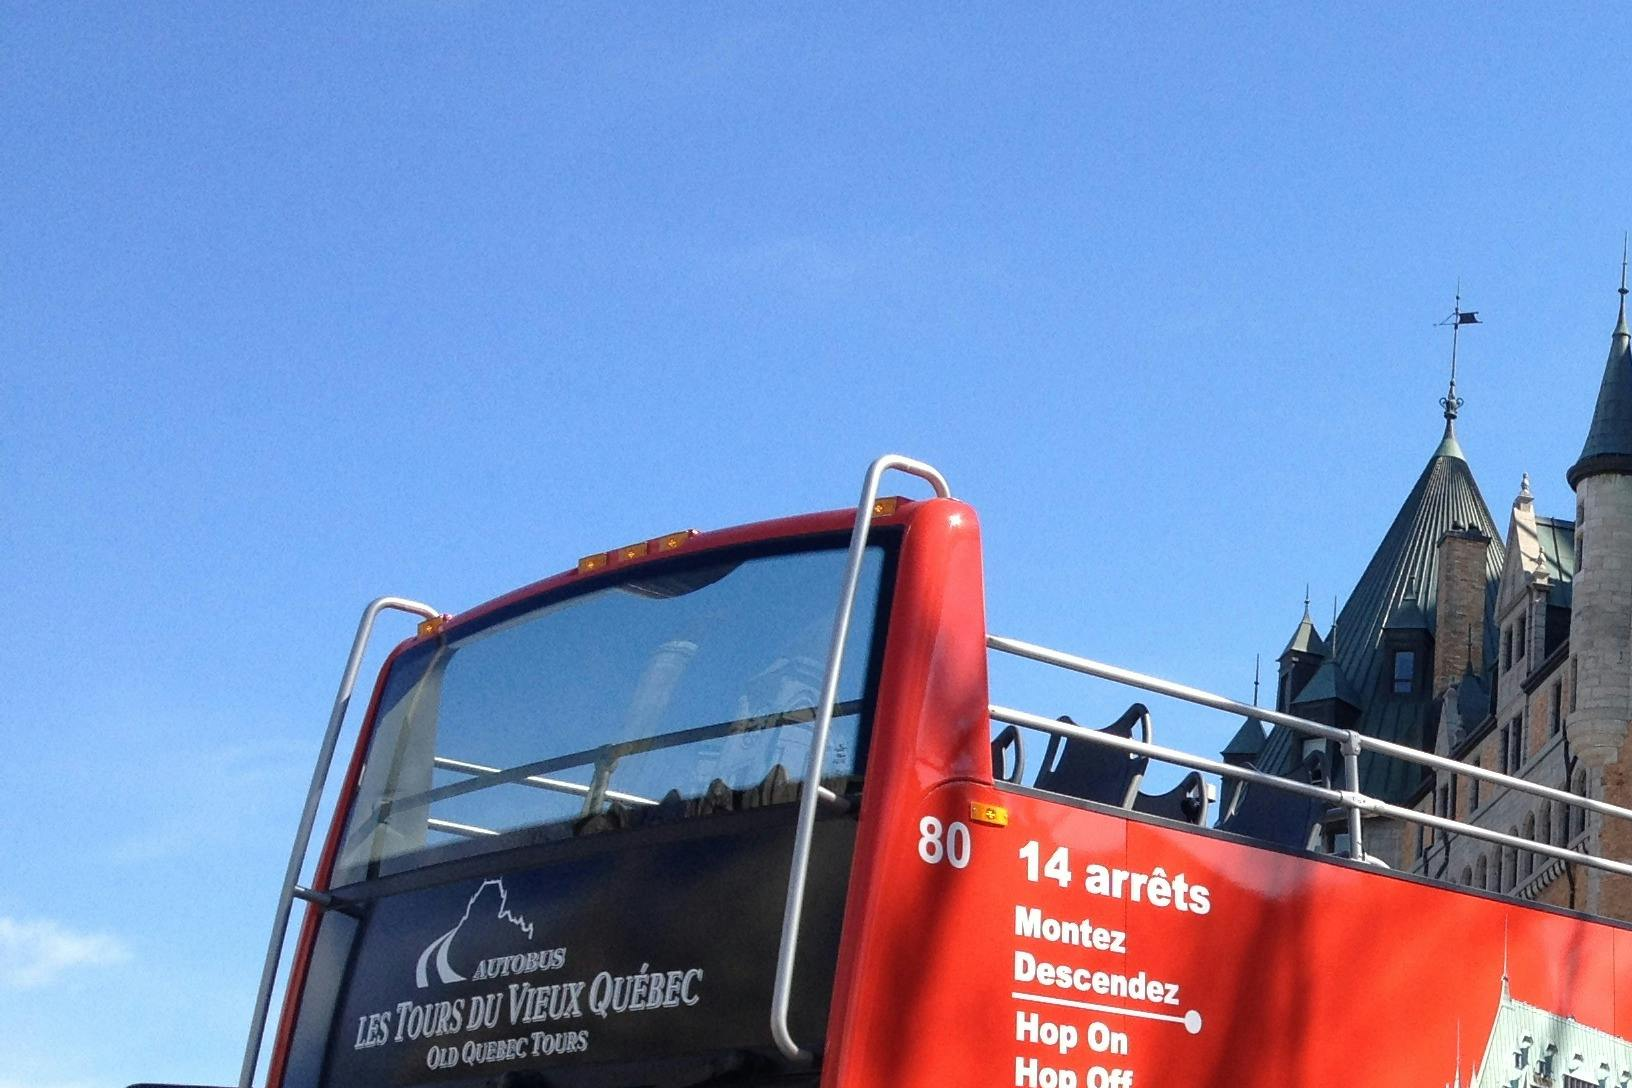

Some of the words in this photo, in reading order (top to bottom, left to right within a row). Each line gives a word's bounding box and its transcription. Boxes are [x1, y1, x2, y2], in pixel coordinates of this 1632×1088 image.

[918, 815, 971, 869] 80
[1019, 840, 1072, 888] 14
[1085, 866, 1211, 915] arrêts
[1014, 905, 1126, 954] Montez
[472, 947, 567, 980] AUTOBUS
[1013, 950, 1180, 1005] Descendez
[354, 1011, 389, 1050] LES
[396, 1000, 465, 1043] TOURS
[466, 992, 503, 1031] DU
[508, 981, 585, 1026] VIEUX
[588, 962, 703, 1019] QUÉBEC
[426, 1045, 458, 1070] OLD
[462, 1037, 528, 1067] QUEBEC
[531, 1030, 589, 1055] TOURS
[1015, 1011, 1078, 1054] Hop
[1087, 1021, 1128, 1055] On
